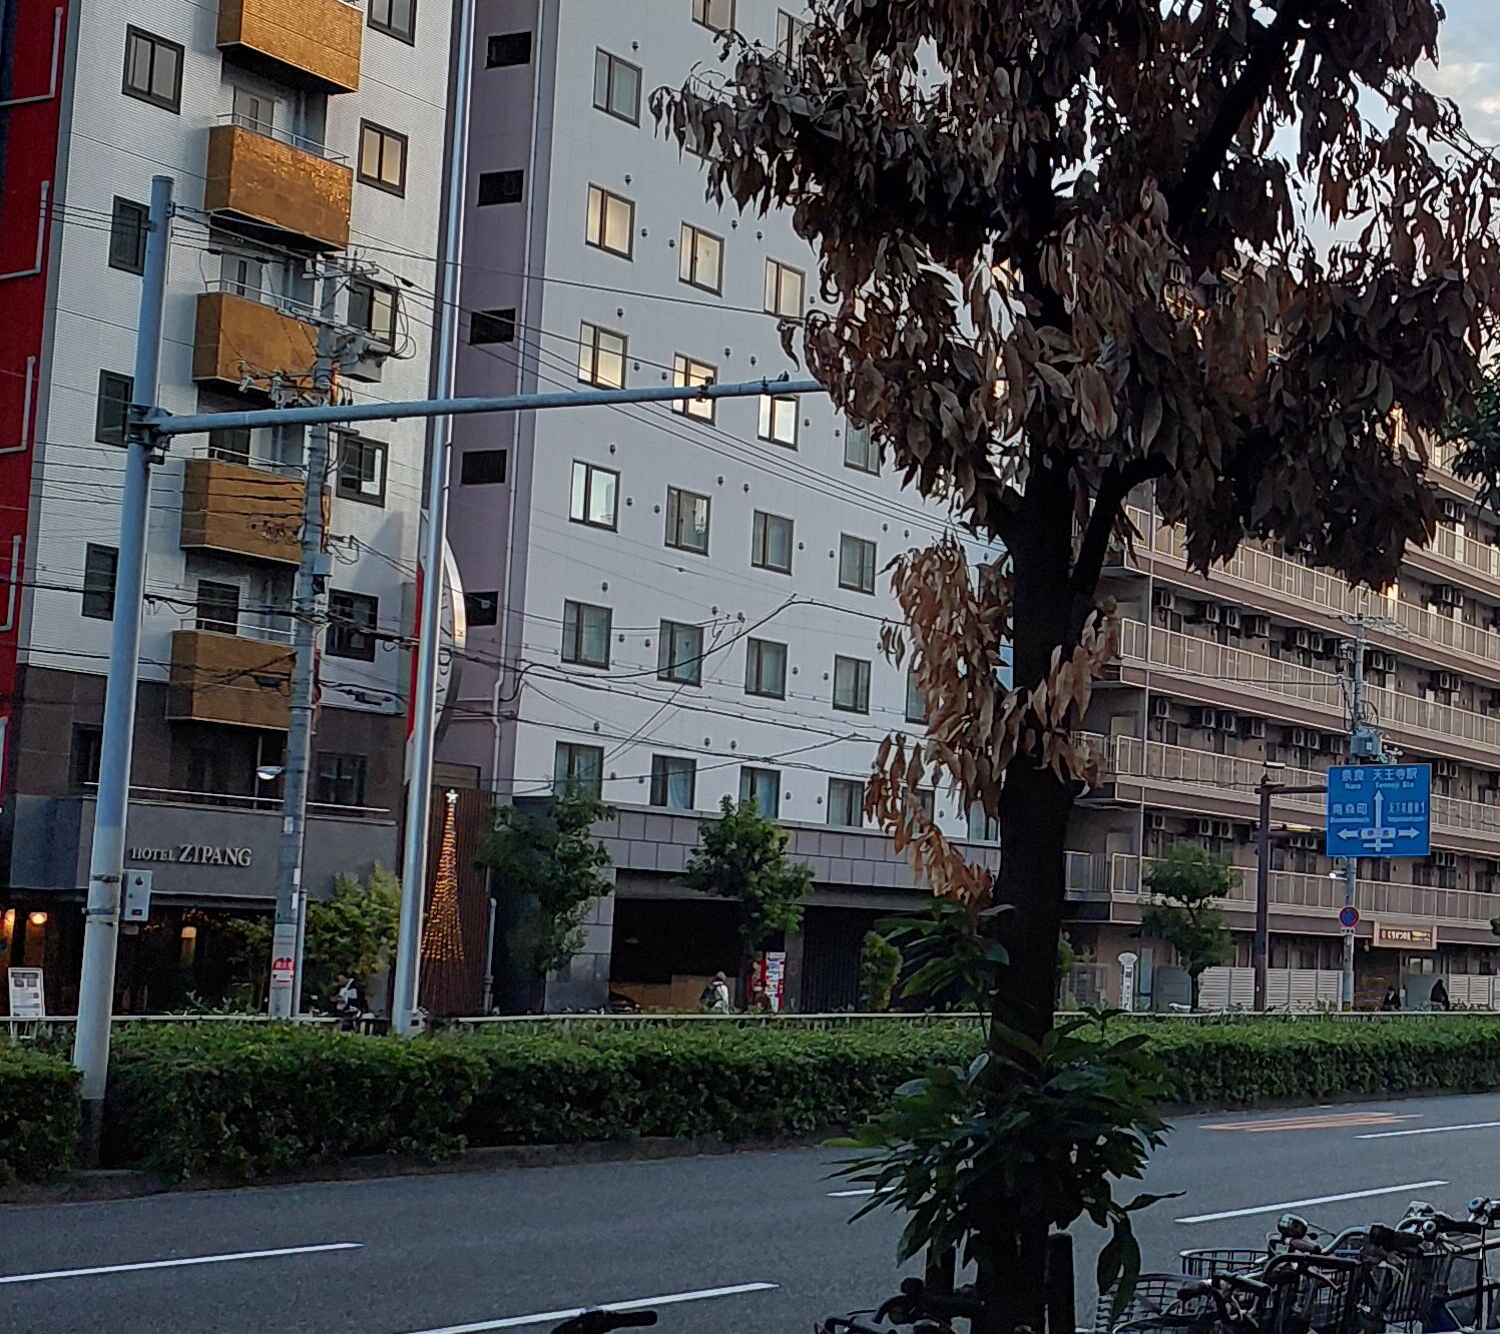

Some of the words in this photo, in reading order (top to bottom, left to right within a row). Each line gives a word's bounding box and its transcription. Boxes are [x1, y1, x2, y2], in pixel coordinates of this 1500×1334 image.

[1372, 767, 1418, 781] 天王寺駅
[131, 847, 176, 862] HOTEL
[178, 844, 254, 867] ZIPANG
